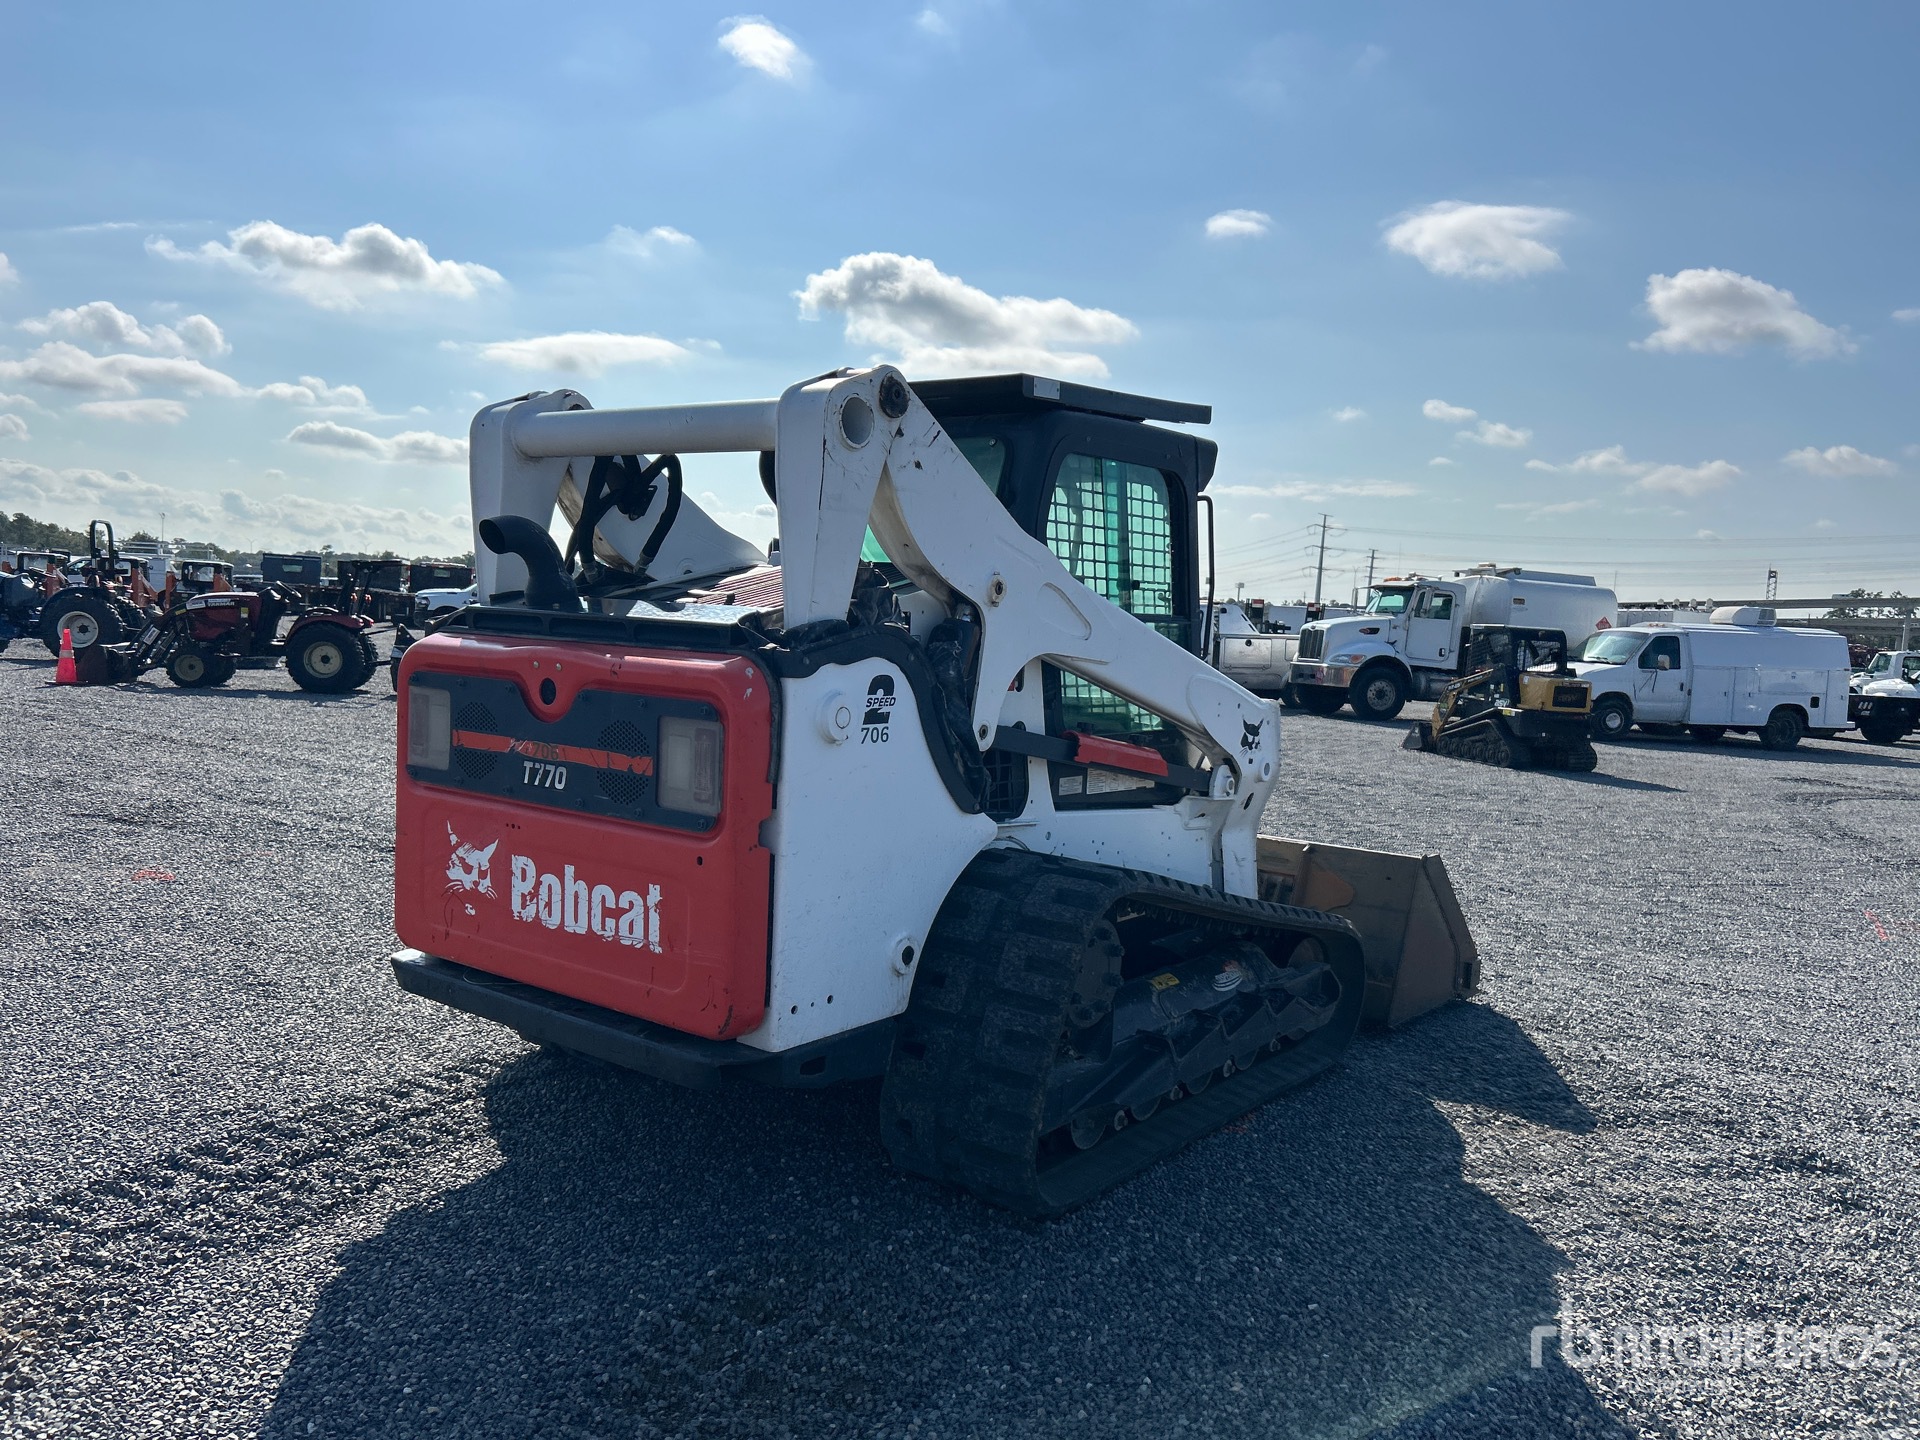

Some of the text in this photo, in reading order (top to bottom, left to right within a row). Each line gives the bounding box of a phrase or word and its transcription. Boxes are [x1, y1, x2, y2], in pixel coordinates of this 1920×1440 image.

[863, 674, 895, 725] 2
[866, 696, 896, 708] SPEED
[861, 726, 889, 744] 706
[533, 741, 559, 761] 706
[523, 760, 567, 790] T770
[511, 854, 663, 954] Bobcat
